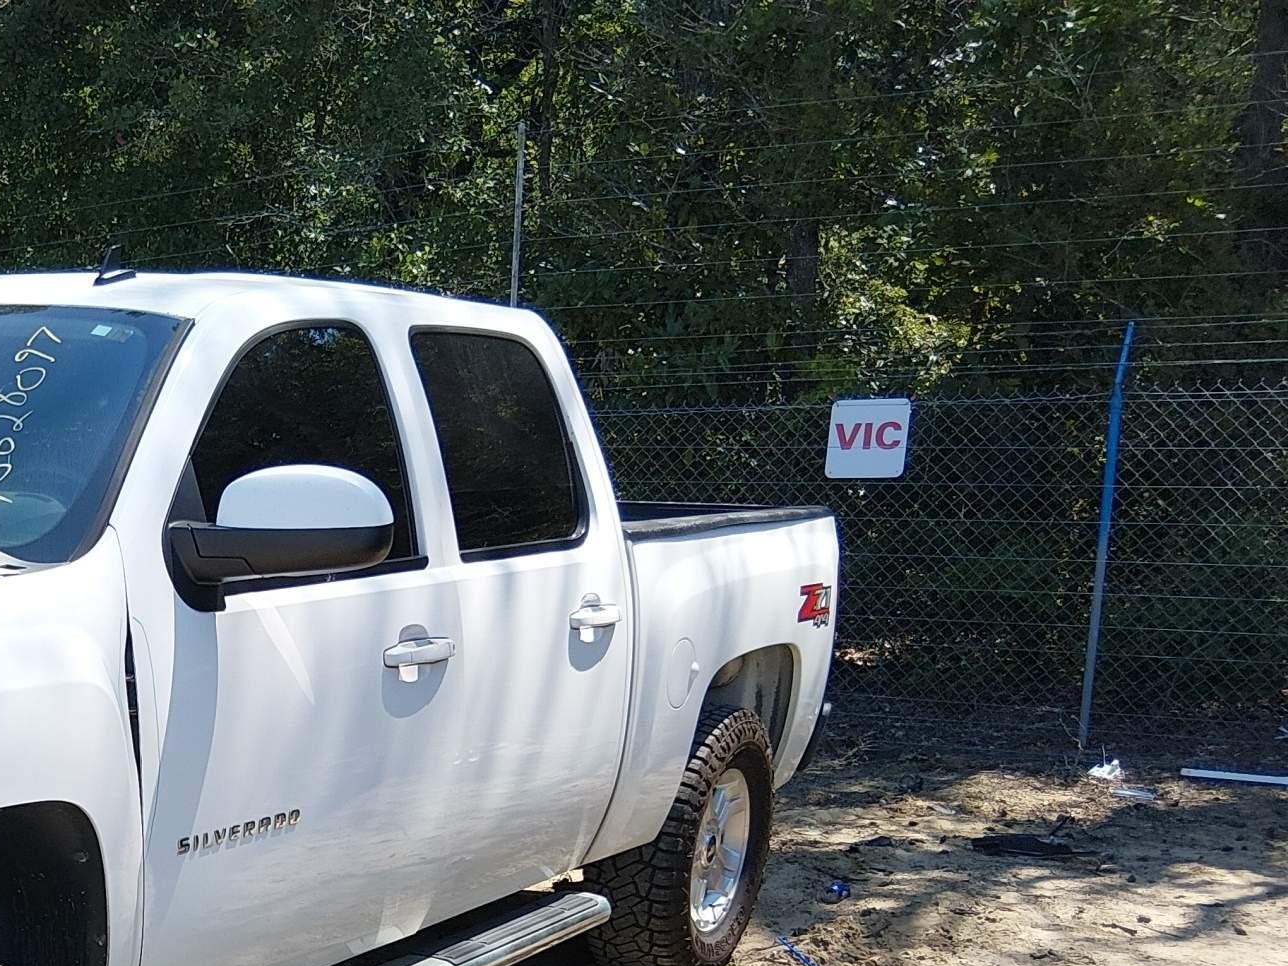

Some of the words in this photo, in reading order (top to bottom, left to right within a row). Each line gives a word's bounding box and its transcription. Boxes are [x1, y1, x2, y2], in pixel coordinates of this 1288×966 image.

[835, 421, 902, 450] VIC
[798, 583, 832, 623] Z71
[177, 808, 300, 856] SILVERADO
